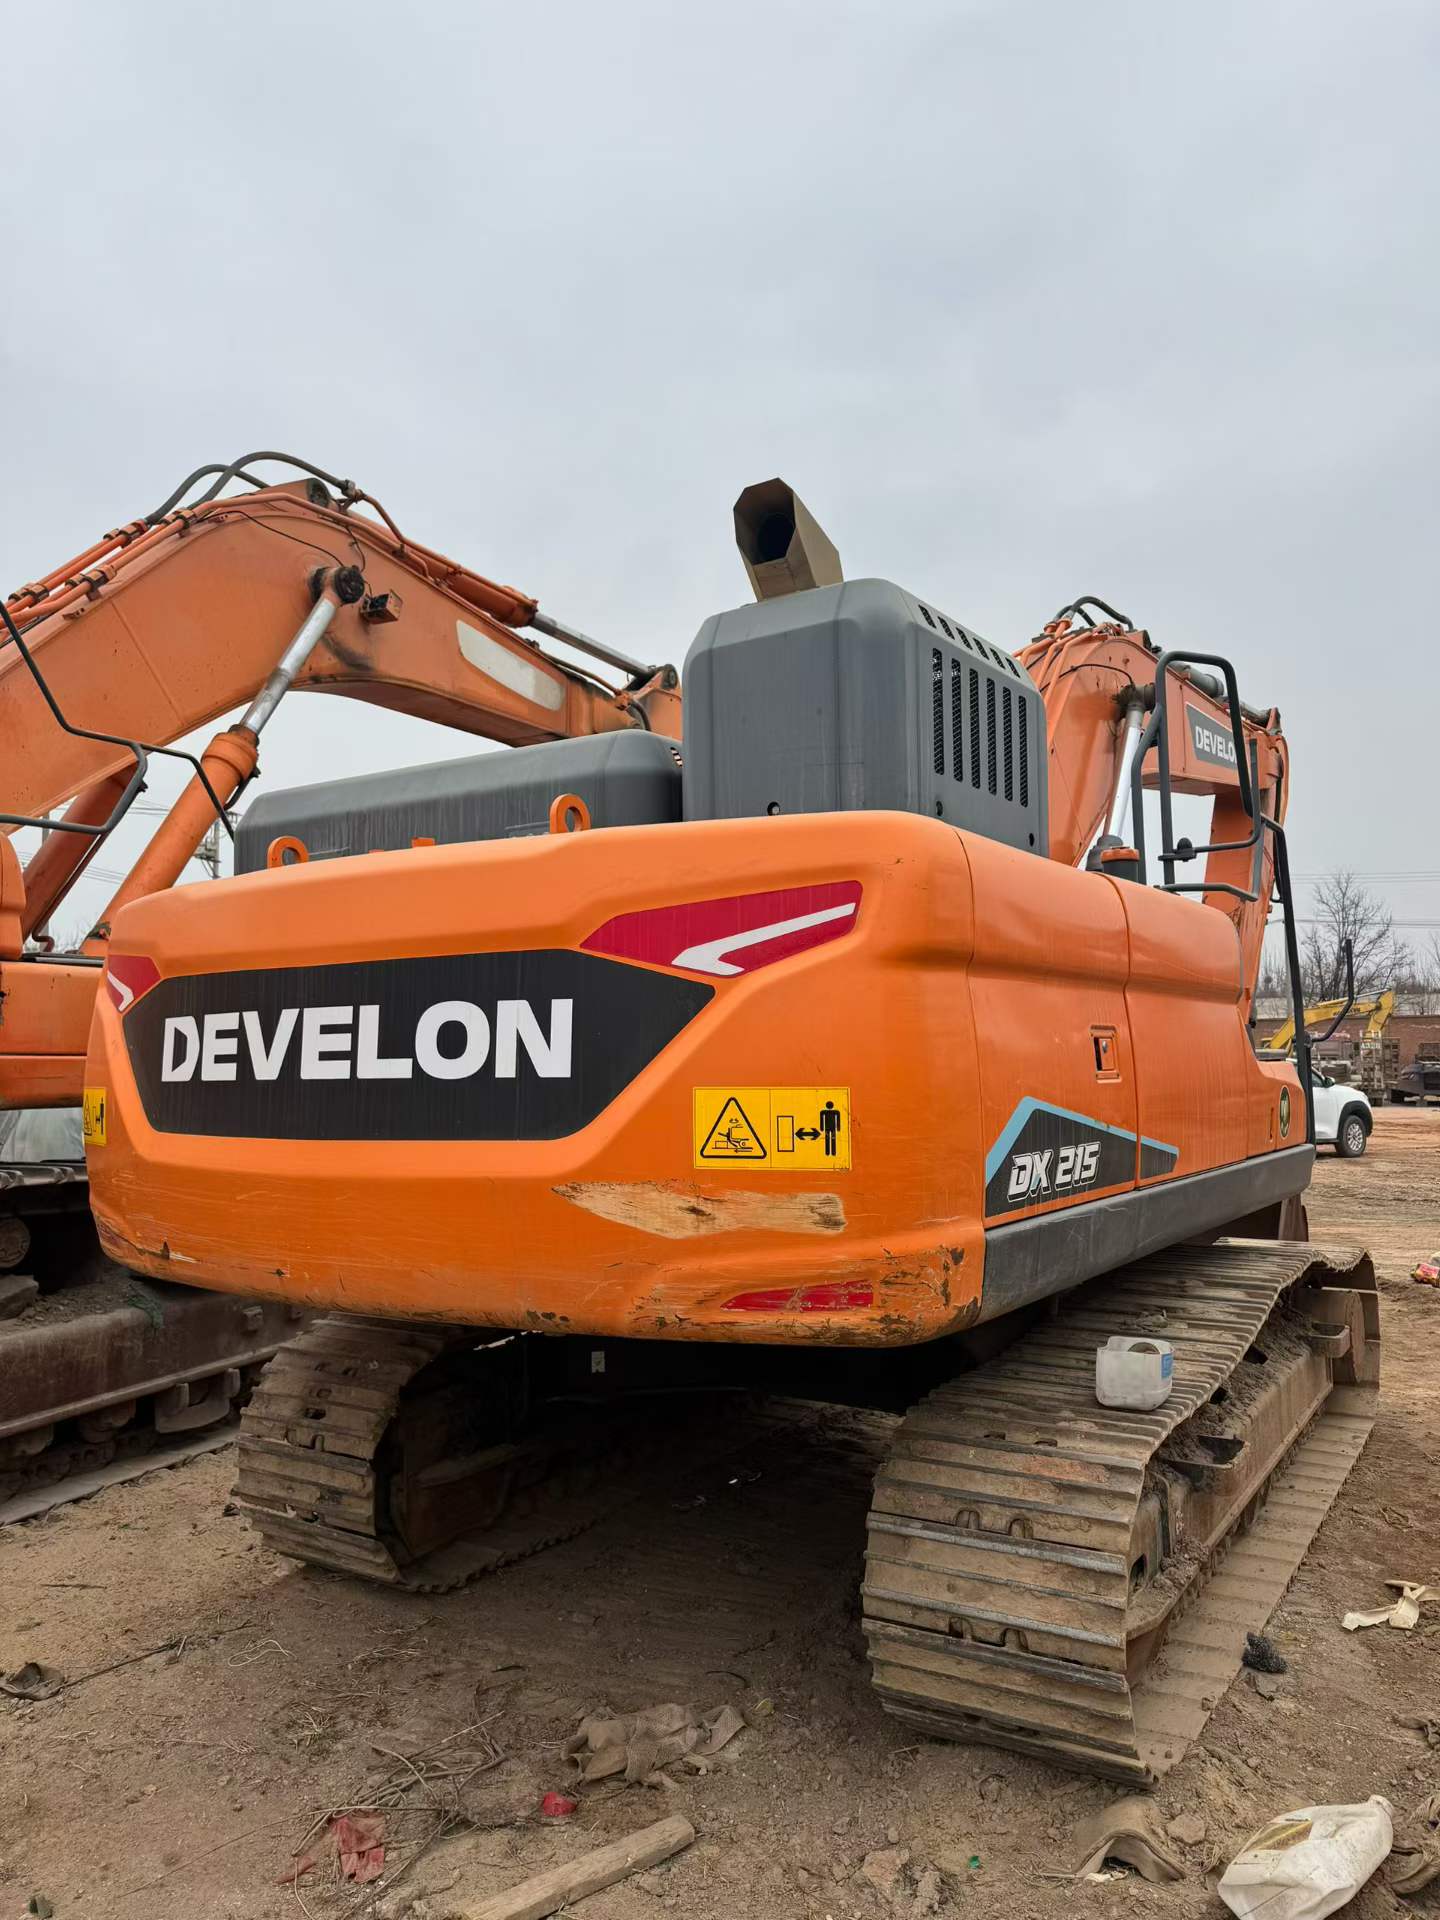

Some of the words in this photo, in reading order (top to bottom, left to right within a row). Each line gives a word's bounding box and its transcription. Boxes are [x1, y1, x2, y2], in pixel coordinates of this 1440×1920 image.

[1195, 726, 1238, 765] DEVELO
[161, 998, 573, 1082] DEVELON
[1007, 1149, 1054, 1202] DX
[1054, 1141, 1101, 1191] 215
